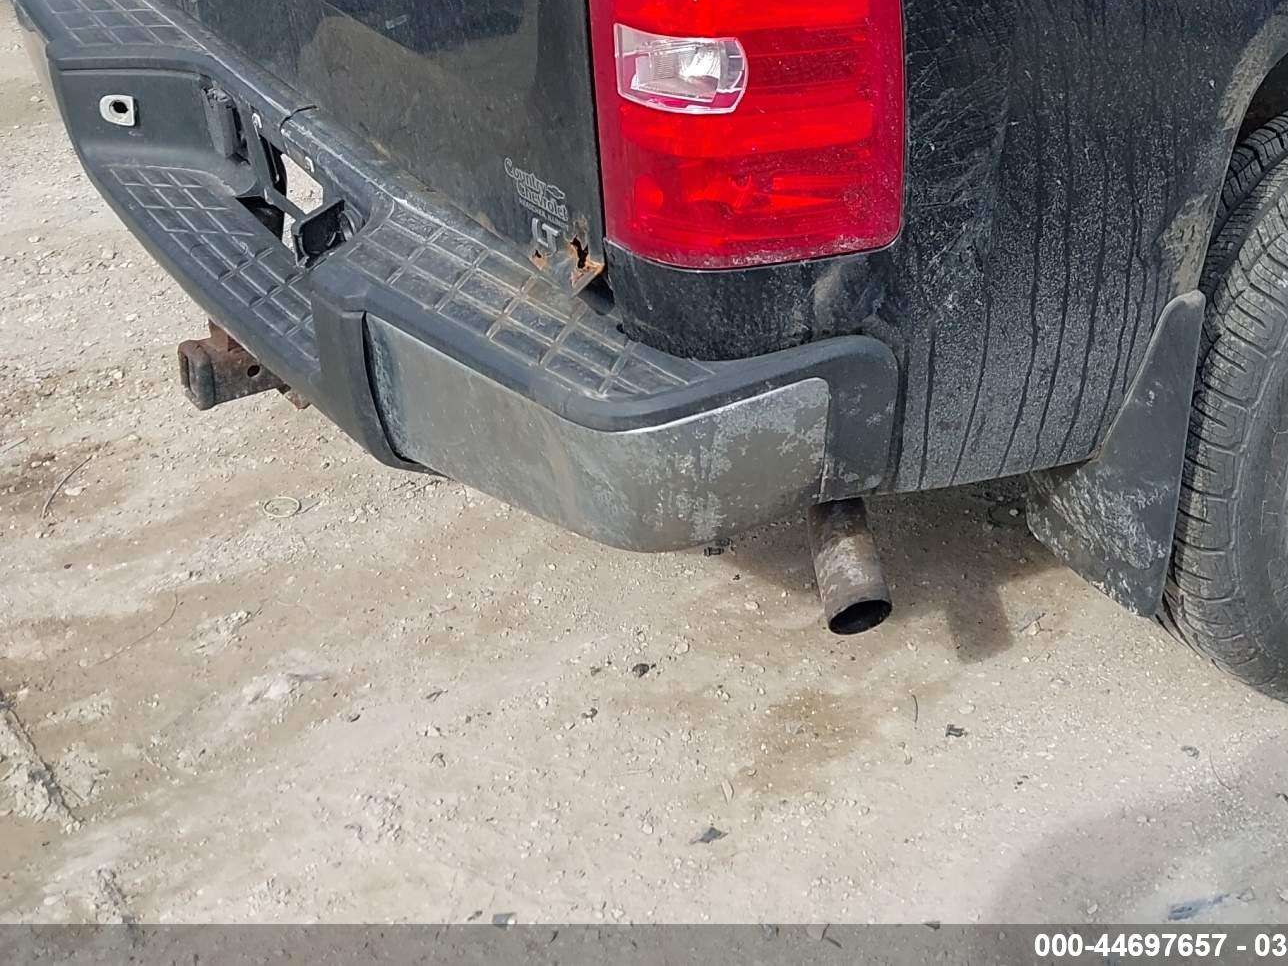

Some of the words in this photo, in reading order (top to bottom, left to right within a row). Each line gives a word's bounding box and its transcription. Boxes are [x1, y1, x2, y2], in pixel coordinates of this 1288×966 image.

[504, 157, 547, 200] Country
[516, 180, 569, 222] Chevrolet
[531, 217, 560, 253] LT
